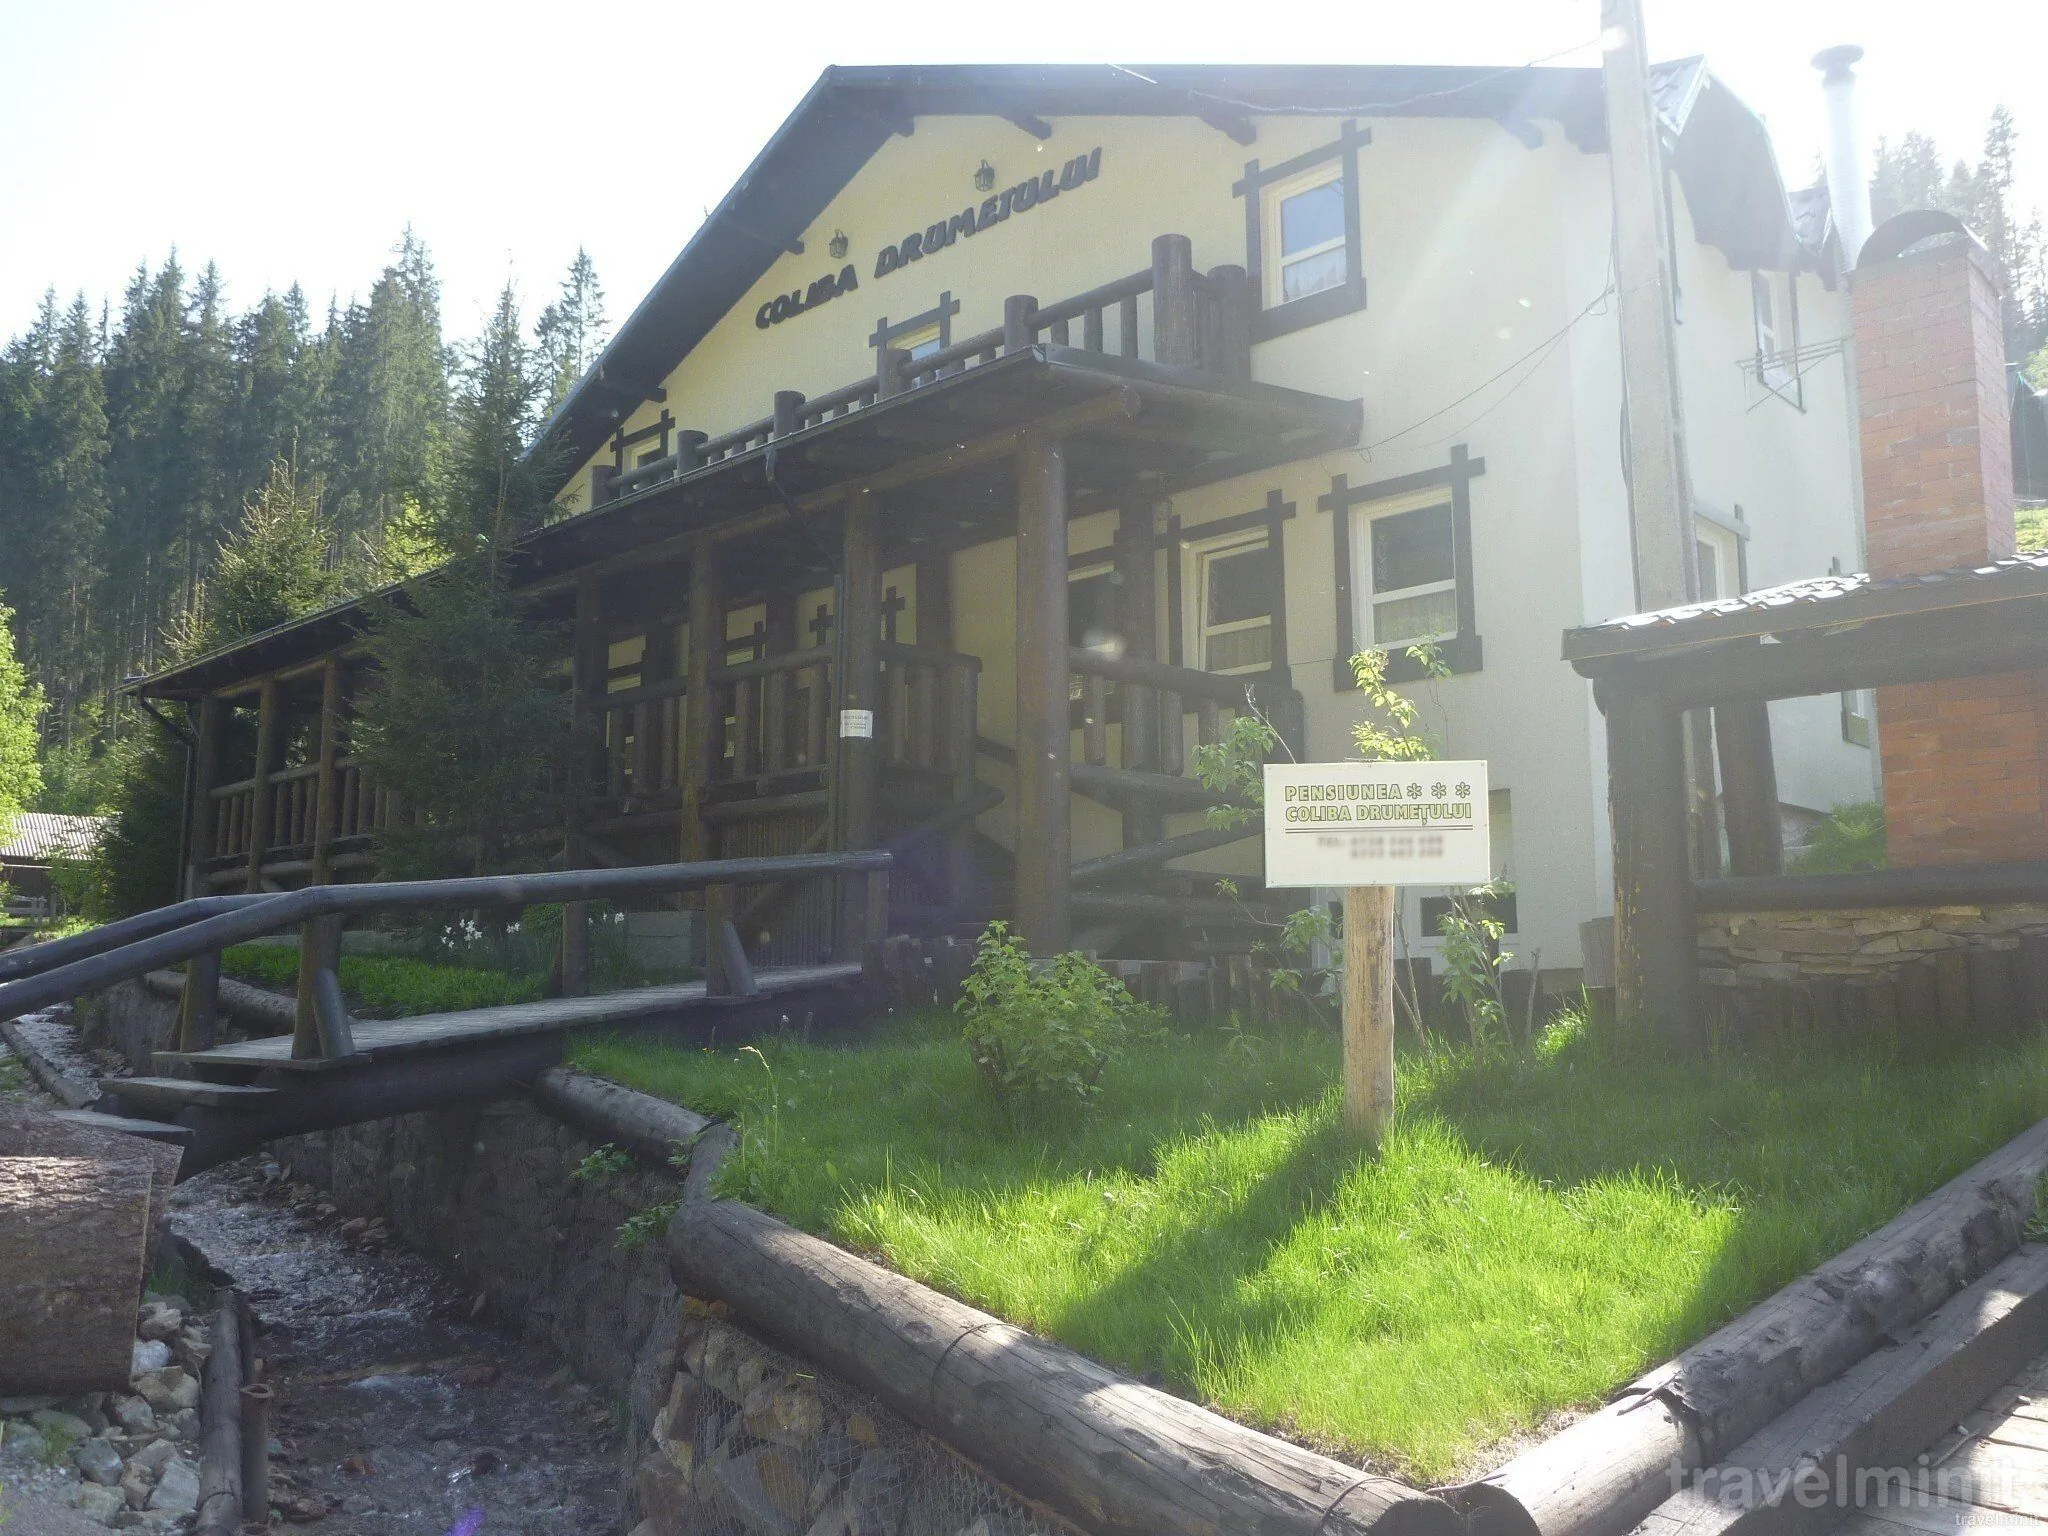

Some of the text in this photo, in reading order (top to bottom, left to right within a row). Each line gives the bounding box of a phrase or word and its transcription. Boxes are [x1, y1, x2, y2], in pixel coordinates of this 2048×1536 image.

[755, 264, 859, 329] COLIBA
[1285, 784, 1402, 801] PENSIUNEA
[1285, 806, 1352, 822] COLIBA
